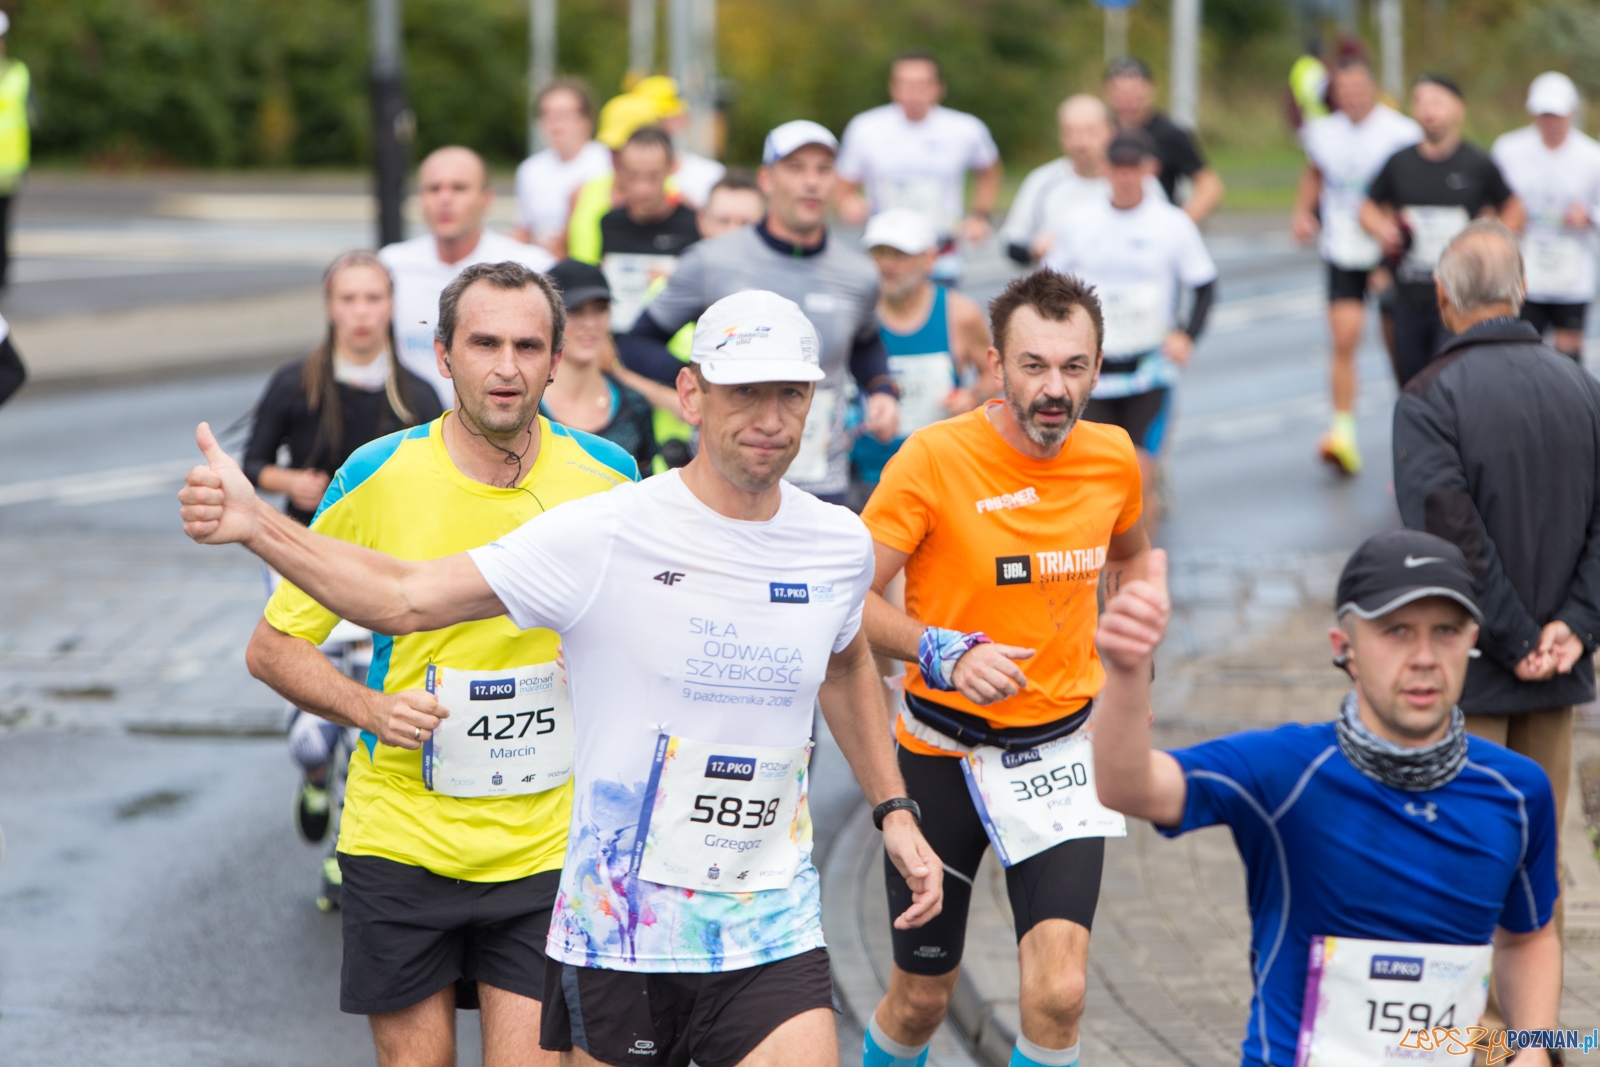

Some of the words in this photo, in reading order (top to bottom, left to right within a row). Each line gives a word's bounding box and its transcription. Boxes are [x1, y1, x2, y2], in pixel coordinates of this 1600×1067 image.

[653, 571, 686, 586] 4F
[1003, 562, 1027, 580] JBL
[689, 617, 738, 639] SIŁA
[703, 640, 804, 664] ODWAGA
[685, 658, 803, 685] SZYBKOŚĆ
[682, 687, 691, 699] 9
[767, 696, 793, 707] 2016
[467, 707, 555, 741] 4275
[490, 746, 536, 759] Marcin
[1010, 762, 1087, 802] 3850
[690, 794, 781, 829] 5838
[704, 834, 762, 853] Grzegorz
[1366, 1000, 1457, 1036] 1594
